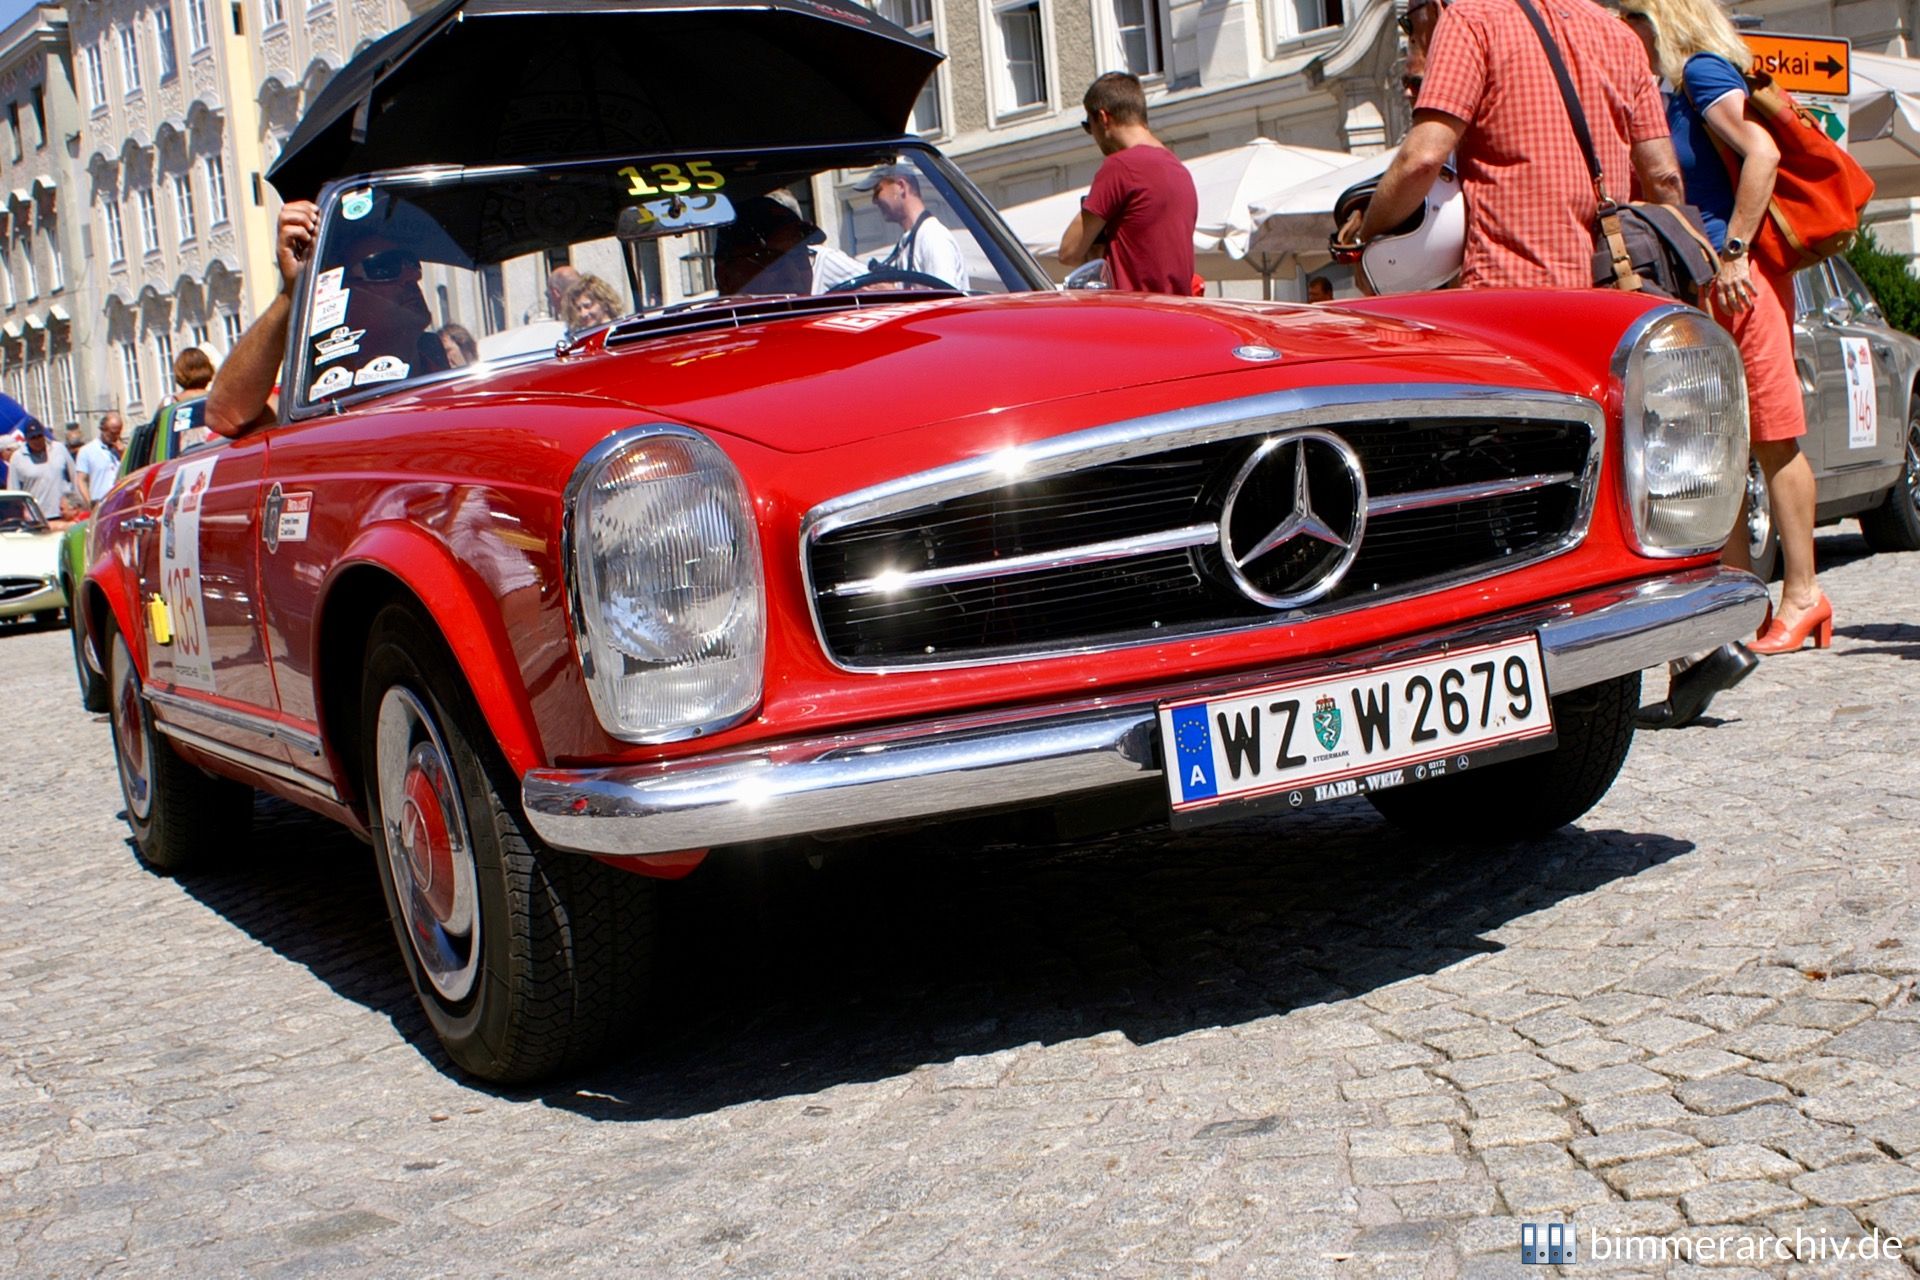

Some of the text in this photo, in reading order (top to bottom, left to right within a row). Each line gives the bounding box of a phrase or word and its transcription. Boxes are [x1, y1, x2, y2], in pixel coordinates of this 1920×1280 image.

[1752, 49, 1809, 76] nskai
[617, 160, 726, 196] 135
[1853, 389, 1872, 433] 146
[167, 567, 199, 656] 135
[1216, 698, 1307, 780] WZ
[1312, 750, 1350, 763] STEIERMARK
[1189, 764, 1207, 787] A
